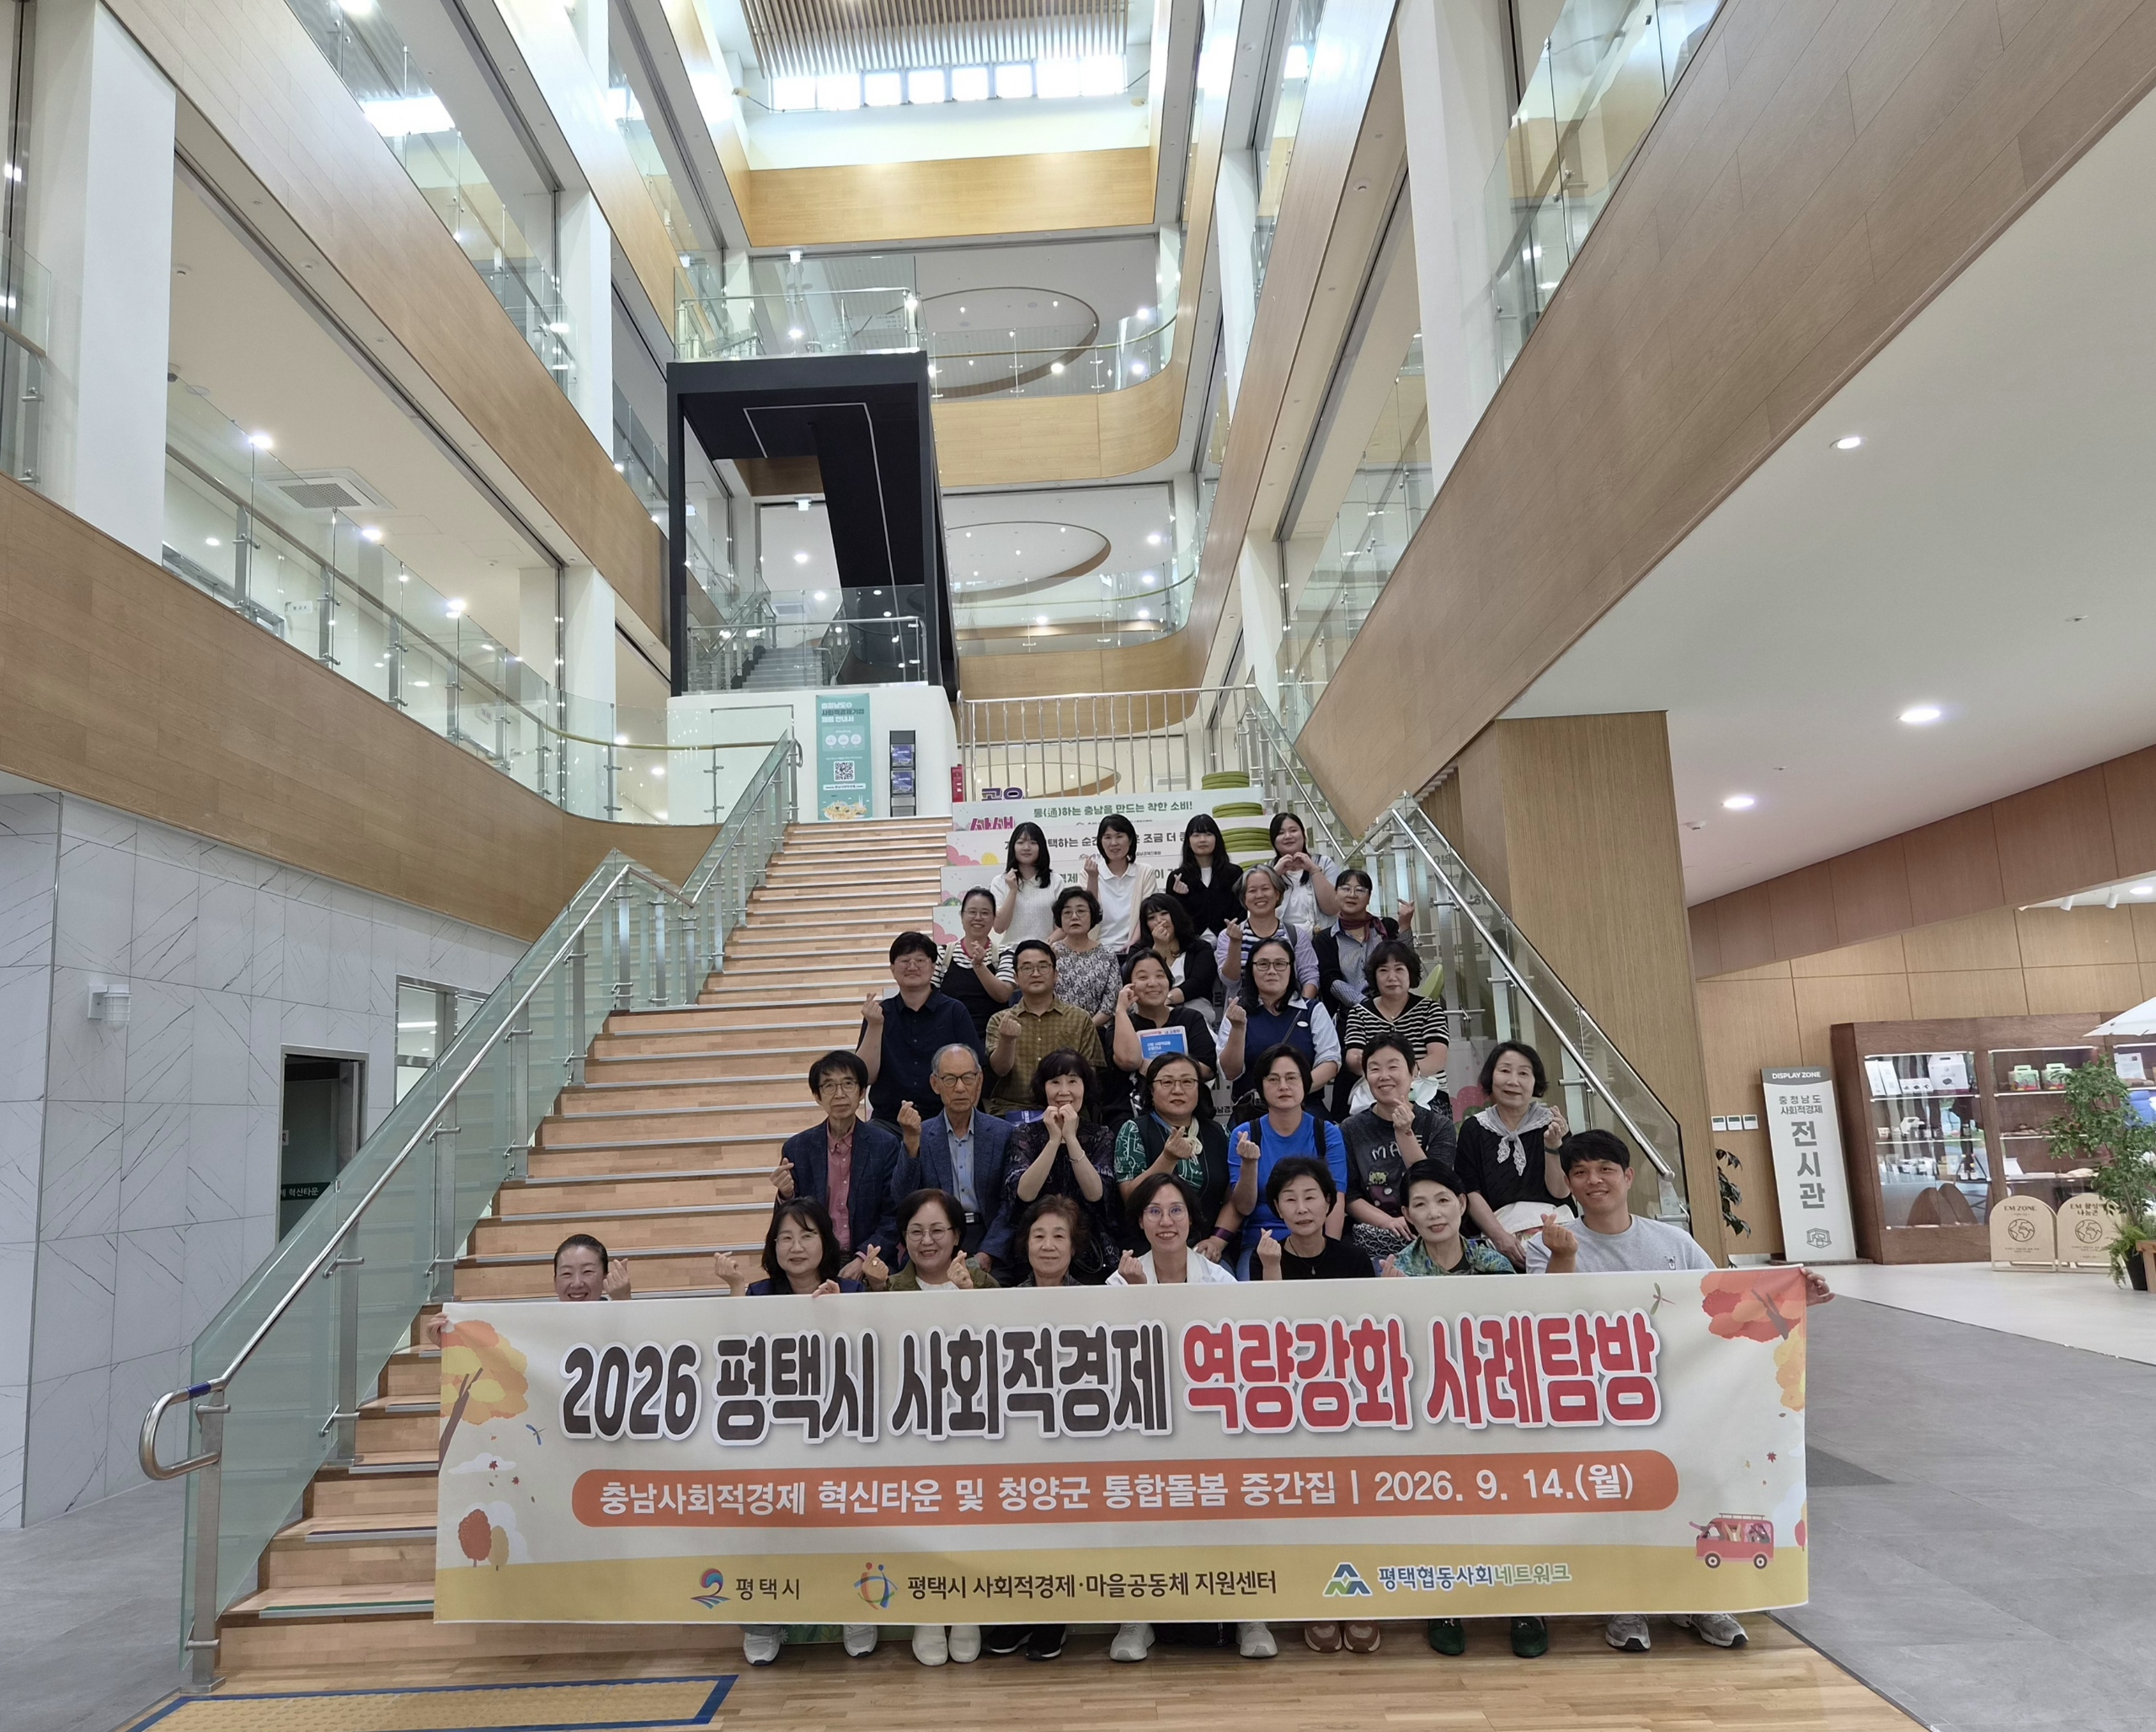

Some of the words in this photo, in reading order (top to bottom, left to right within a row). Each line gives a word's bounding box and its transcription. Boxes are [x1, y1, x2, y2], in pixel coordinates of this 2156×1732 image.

[1084, 805, 1113, 815] 충남을
[1116, 803, 1145, 813] 만드는
[1148, 802, 1167, 811] 착한
[1171, 800, 1193, 810] 소비!
[1048, 837, 1081, 848] 택하는
[1143, 833, 1163, 843] 조금
[1166, 832, 1176, 842] 더
[1780, 1105, 1822, 1115] 사회적경제
[289, 1187, 318, 1196] 혁신타운
[561, 1343, 699, 1438] 2026
[717, 1330, 878, 1441] 평택시
[892, 1323, 1169, 1436] 사회적경제
[1182, 1317, 1410, 1430] 역량강화
[1426, 1310, 1657, 1426] 사례탐방
[600, 1481, 805, 1516] 충남사회적경제
[819, 1478, 942, 1515] 혁신타운
[956, 1479, 984, 1512] 및
[998, 1475, 1091, 1511] 청양군
[1102, 1472, 1228, 1510] 통합돌봄
[1241, 1471, 1336, 1505] 중간집
[1374, 1471, 1464, 1503] 2026.
[1476, 1469, 1508, 1502] 9.
[1523, 1463, 1634, 1502] 14.(월)
[735, 1577, 801, 1601] 평택시
[907, 1575, 966, 1601] 평택시
[1195, 1569, 1278, 1596] 지원센터
[1377, 1562, 1572, 1592] 평택협동사회네트워크
